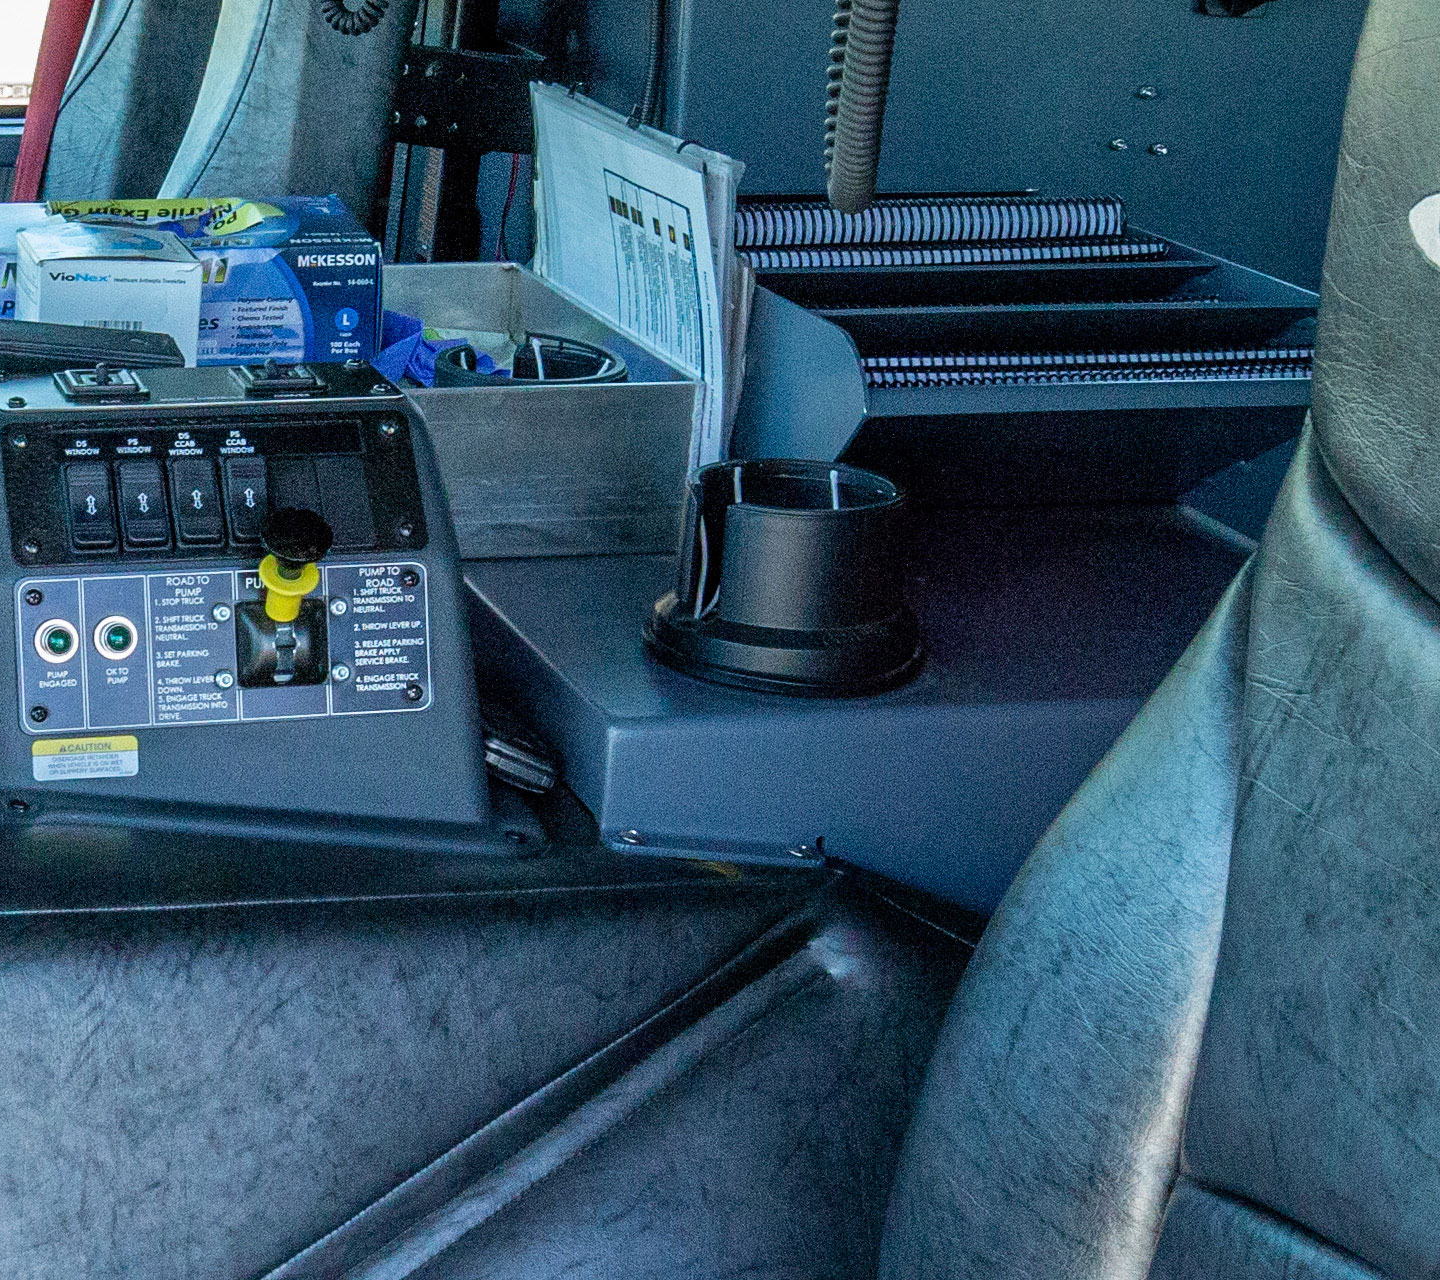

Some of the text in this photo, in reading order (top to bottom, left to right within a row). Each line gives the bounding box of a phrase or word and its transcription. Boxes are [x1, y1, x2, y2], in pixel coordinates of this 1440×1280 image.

[49, 272, 108, 282] VioNex
[343, 314, 350, 325] L
[65, 448, 100, 456] WINDOW
[169, 447, 203, 456] WINDOW
[359, 567, 400, 576] PUMP TO
[166, 576, 210, 586] ROAD TO
[365, 578, 394, 587] ROAD
[175, 588, 201, 597] PUMP
[353, 595, 415, 604] TRANSMISSION TO
[155, 622, 219, 632] TRANSMISSION TO
[392, 638, 424, 646] PARKING
[355, 648, 400, 657] BRAKE APPLY
[47, 671, 69, 679] PUMP
[118, 667, 129, 675] TO
[107, 676, 129, 684] PUMP
[364, 674, 395, 682] ENGAGE
[39, 679, 77, 688] ENGAGED
[159, 701, 228, 711] TRANSMISSION INTO
[68, 743, 111, 752] CAUTION
